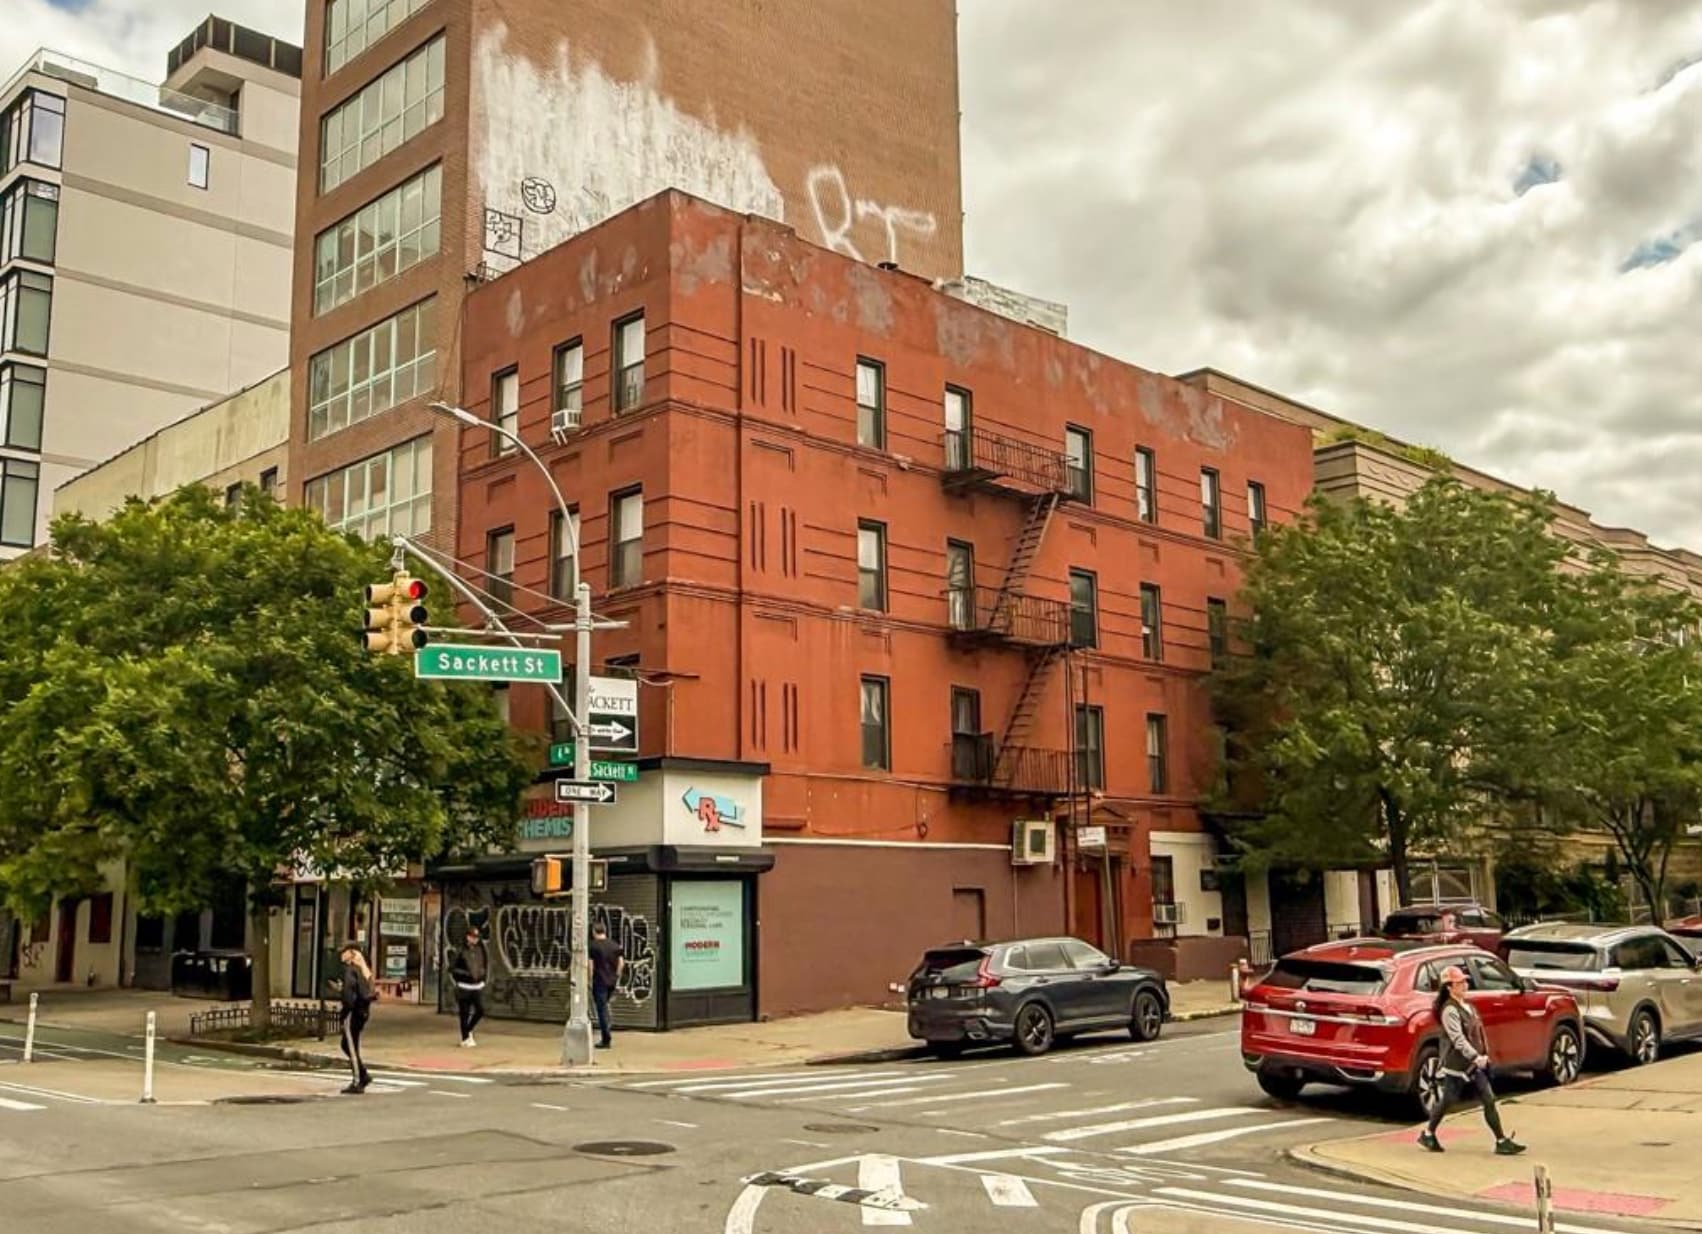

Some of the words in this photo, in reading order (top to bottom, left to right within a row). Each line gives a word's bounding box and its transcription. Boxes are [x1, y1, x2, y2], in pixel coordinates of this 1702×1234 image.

[437, 652, 518, 673] Sackett
[524, 657, 544, 674] St
[591, 762, 626, 779] Sackett
[564, 786, 581, 794] ONE
[589, 788, 607, 796] WAY
